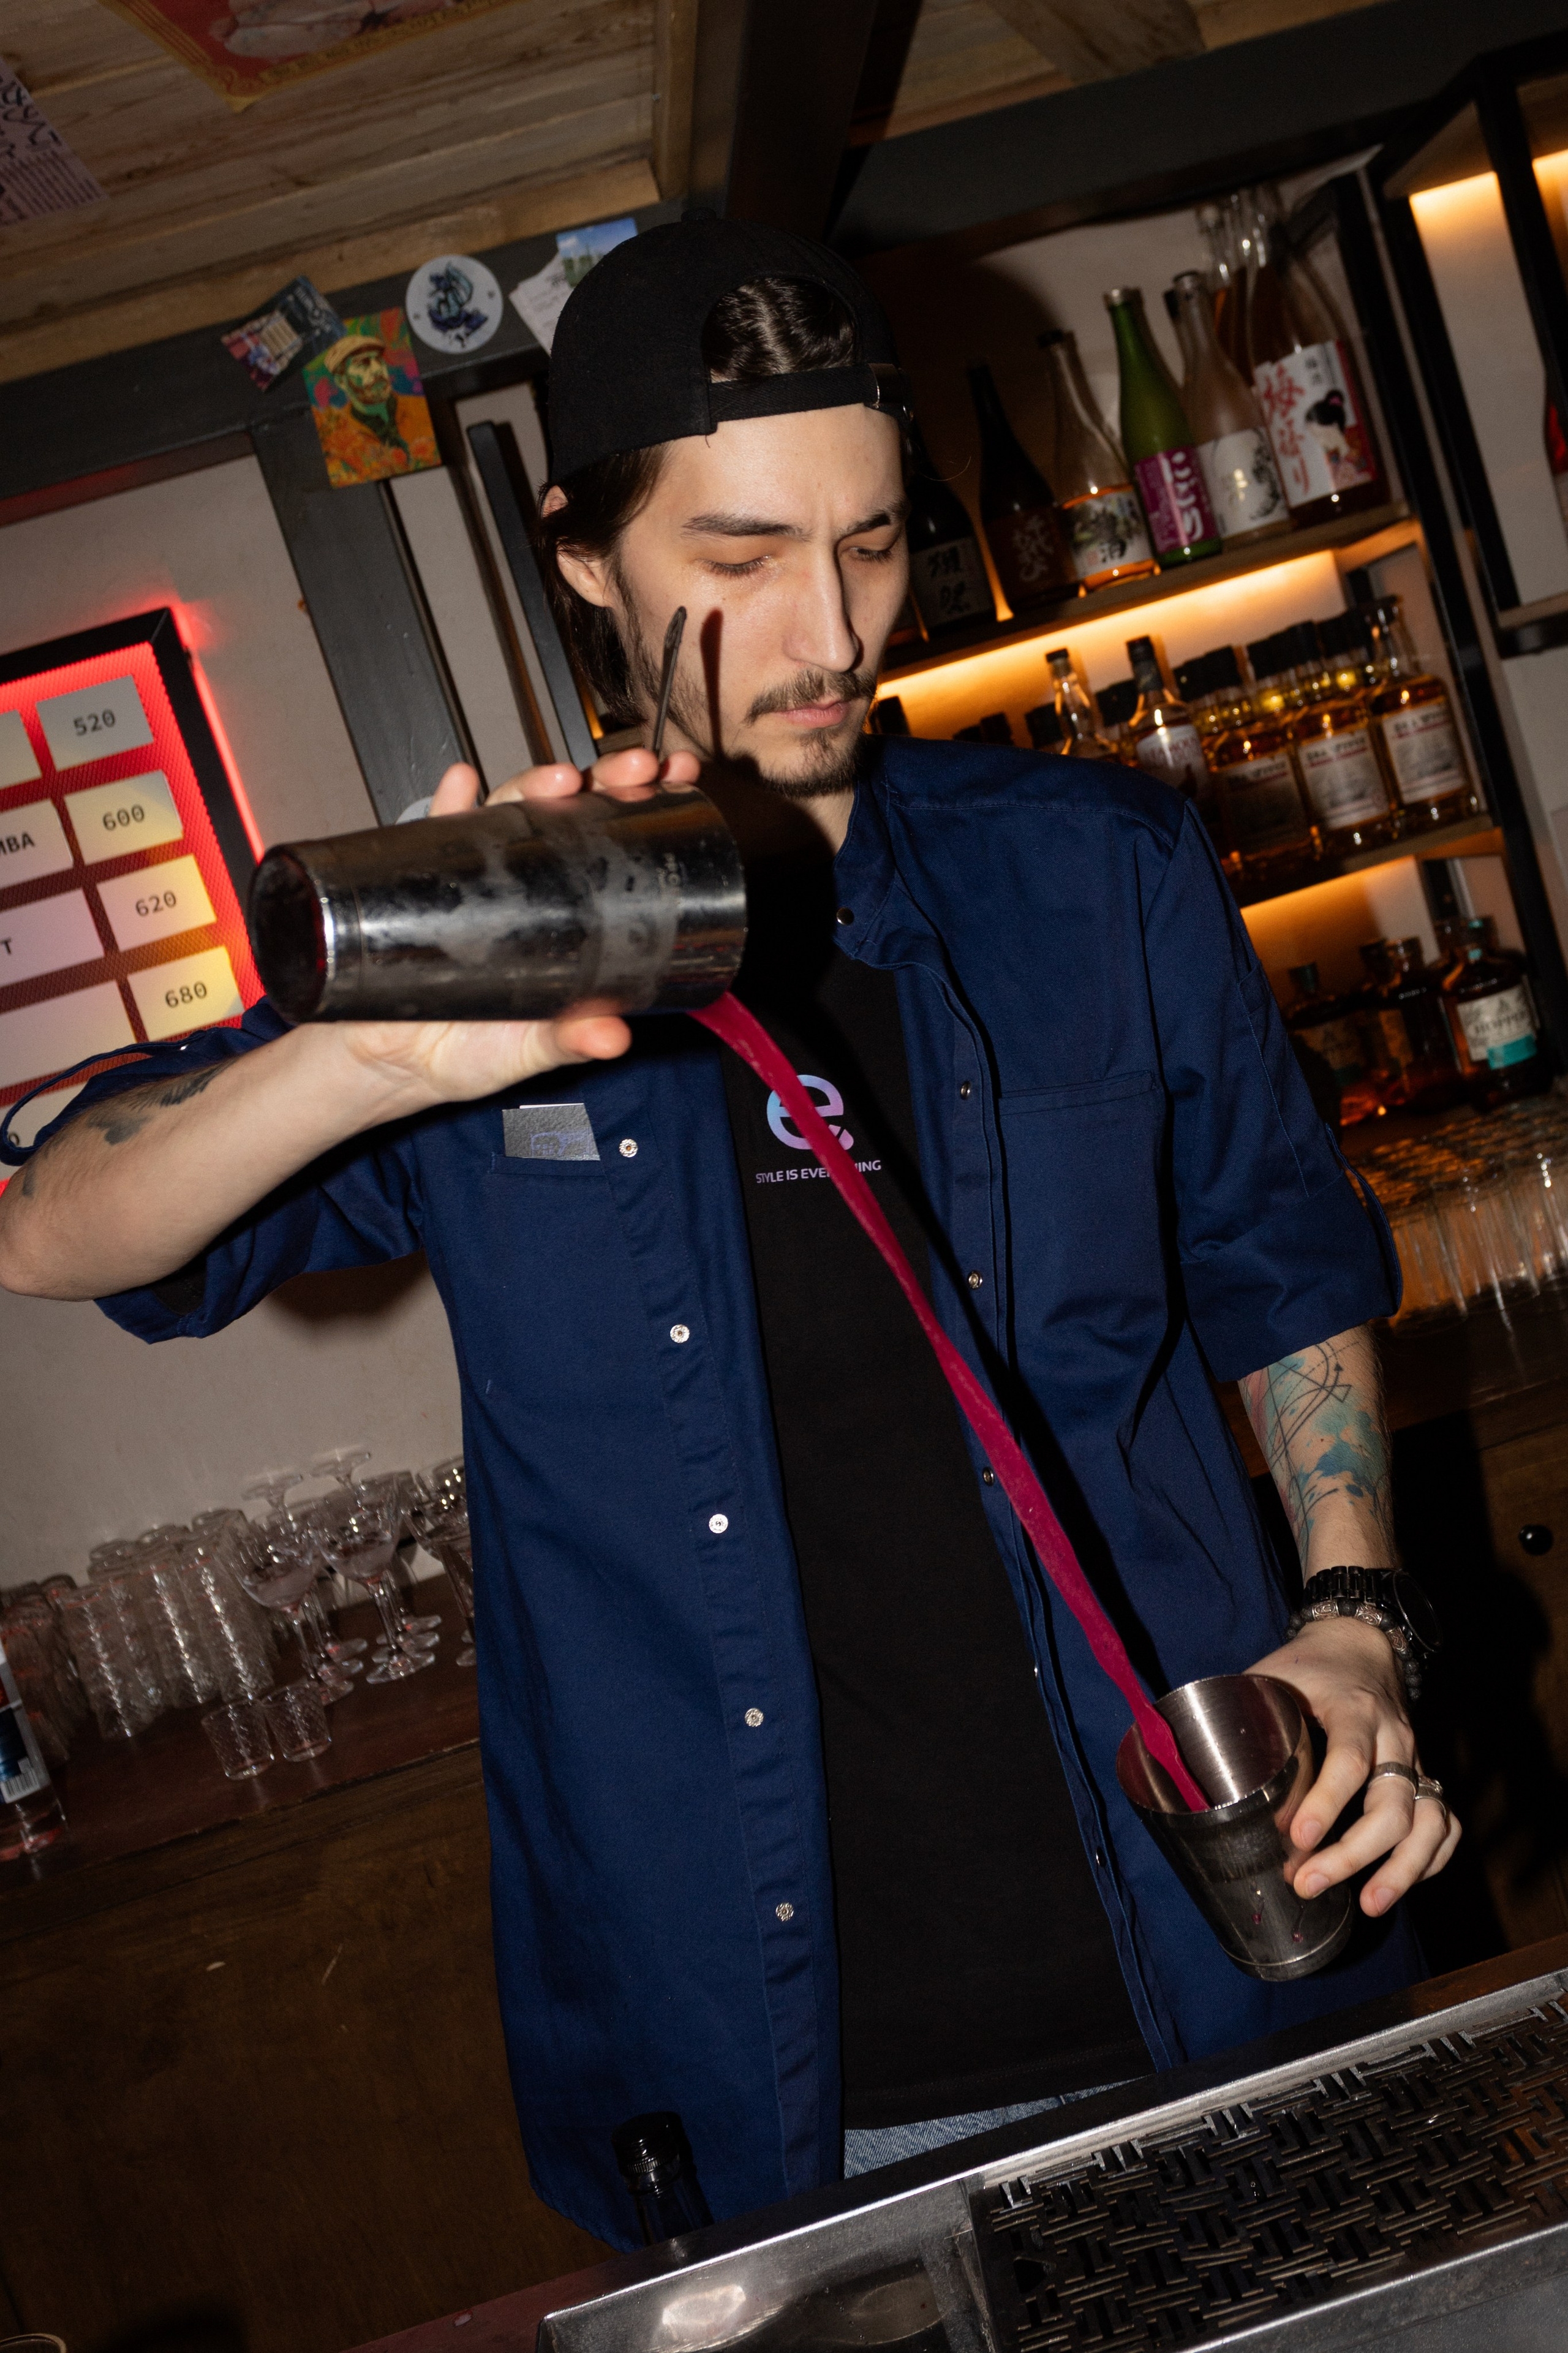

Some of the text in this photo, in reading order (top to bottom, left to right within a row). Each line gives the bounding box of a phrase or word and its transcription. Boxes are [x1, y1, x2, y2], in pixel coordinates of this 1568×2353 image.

[73, 709, 116, 736] 520
[102, 804, 145, 831] 600
[135, 891, 177, 916] 620
[164, 982, 208, 1008] 680
[755, 1160, 882, 1184] STYLE IS EVEING
